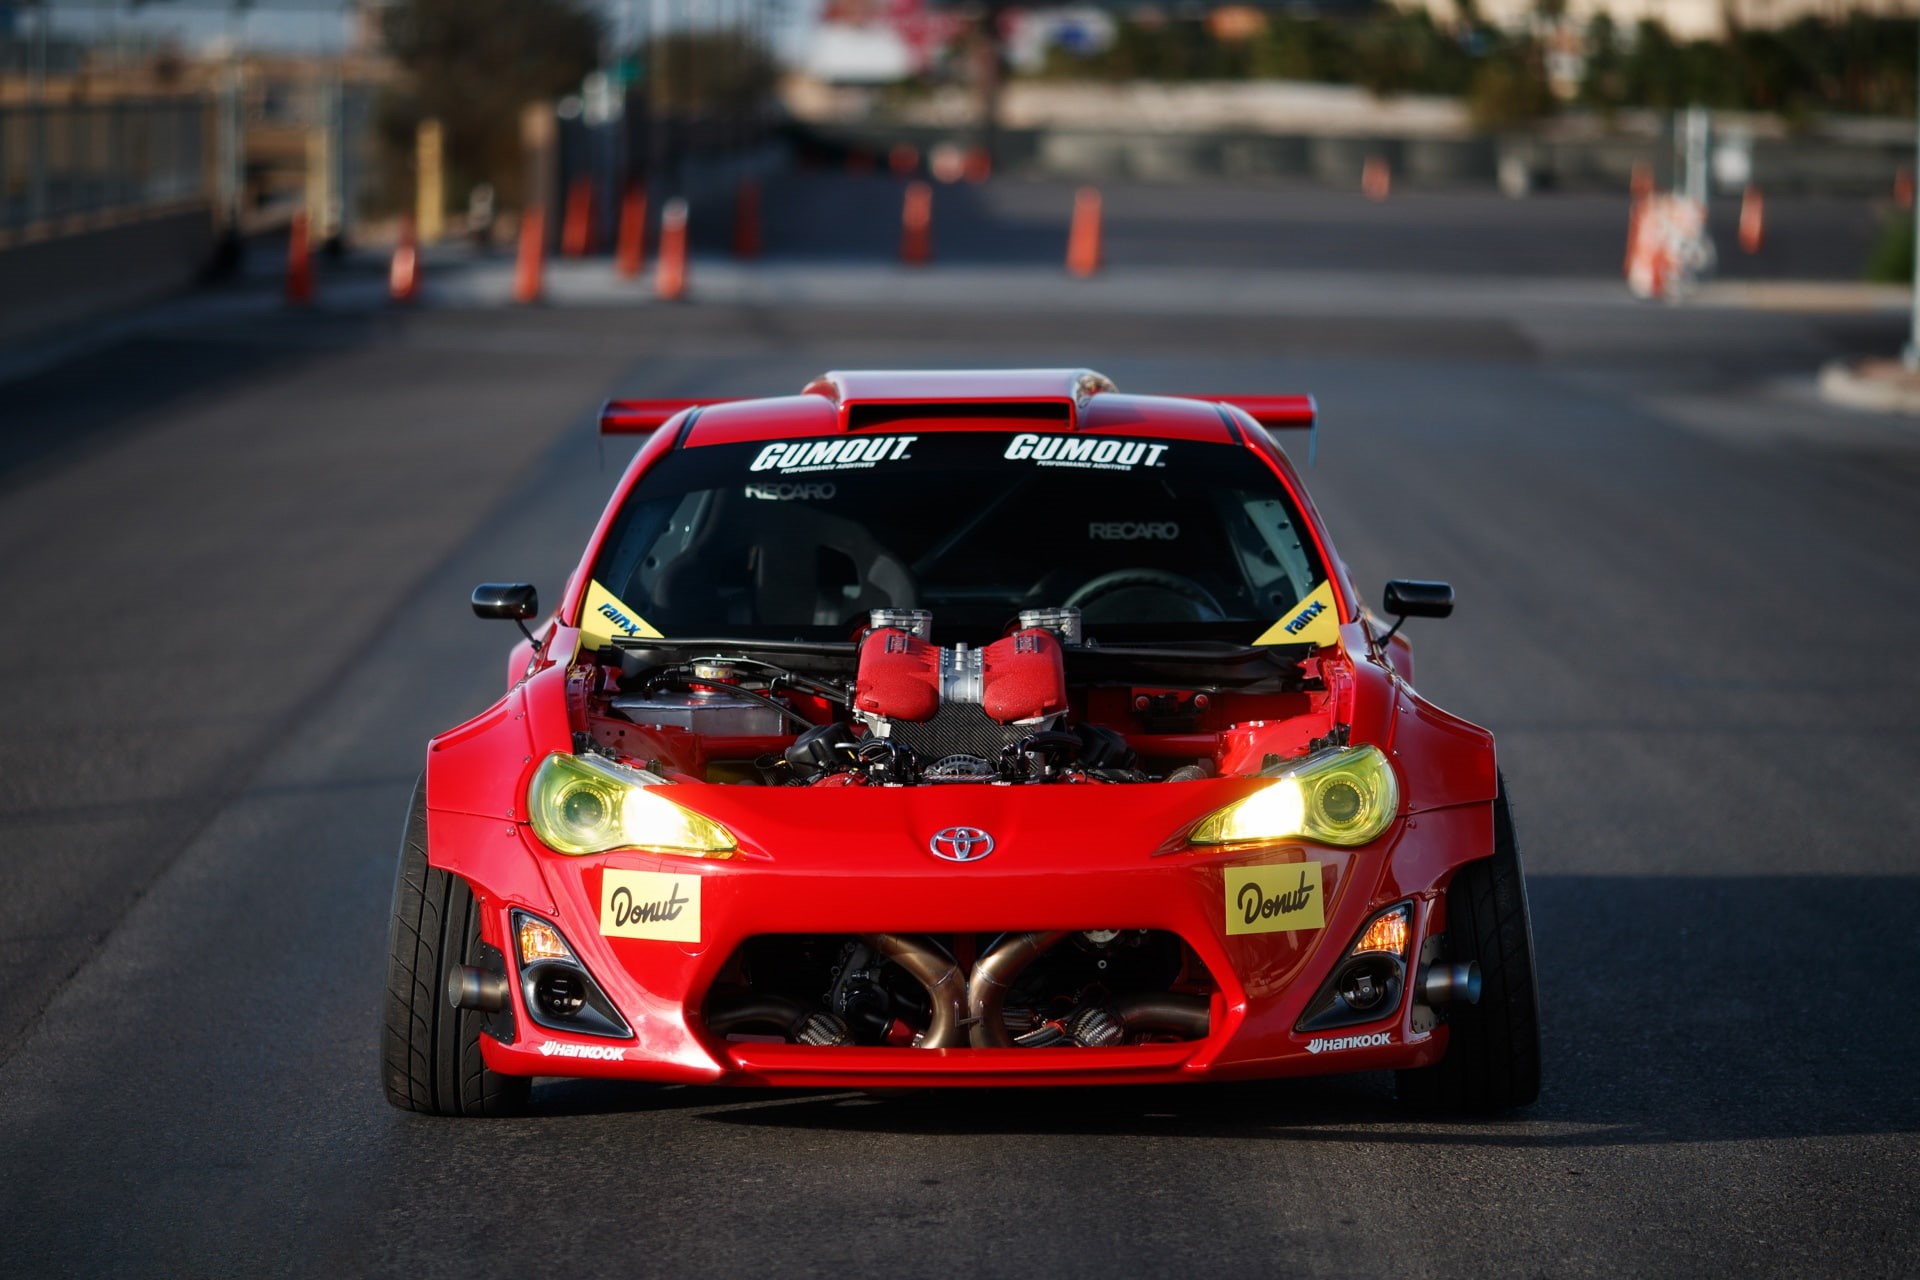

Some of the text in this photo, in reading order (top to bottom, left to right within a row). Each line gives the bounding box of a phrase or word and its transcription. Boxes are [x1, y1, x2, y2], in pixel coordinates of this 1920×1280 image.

[750, 436, 918, 472] GUMOUT
[1003, 433, 1169, 467] GUMOUT
[781, 463, 836, 474] PERFORMANCE
[1037, 460, 1092, 468] PERFORMANCE
[744, 482, 836, 500] RECARO
[1089, 522, 1179, 540] RECARO
[610, 882, 690, 927] Donut
[1237, 870, 1315, 925] Donut
